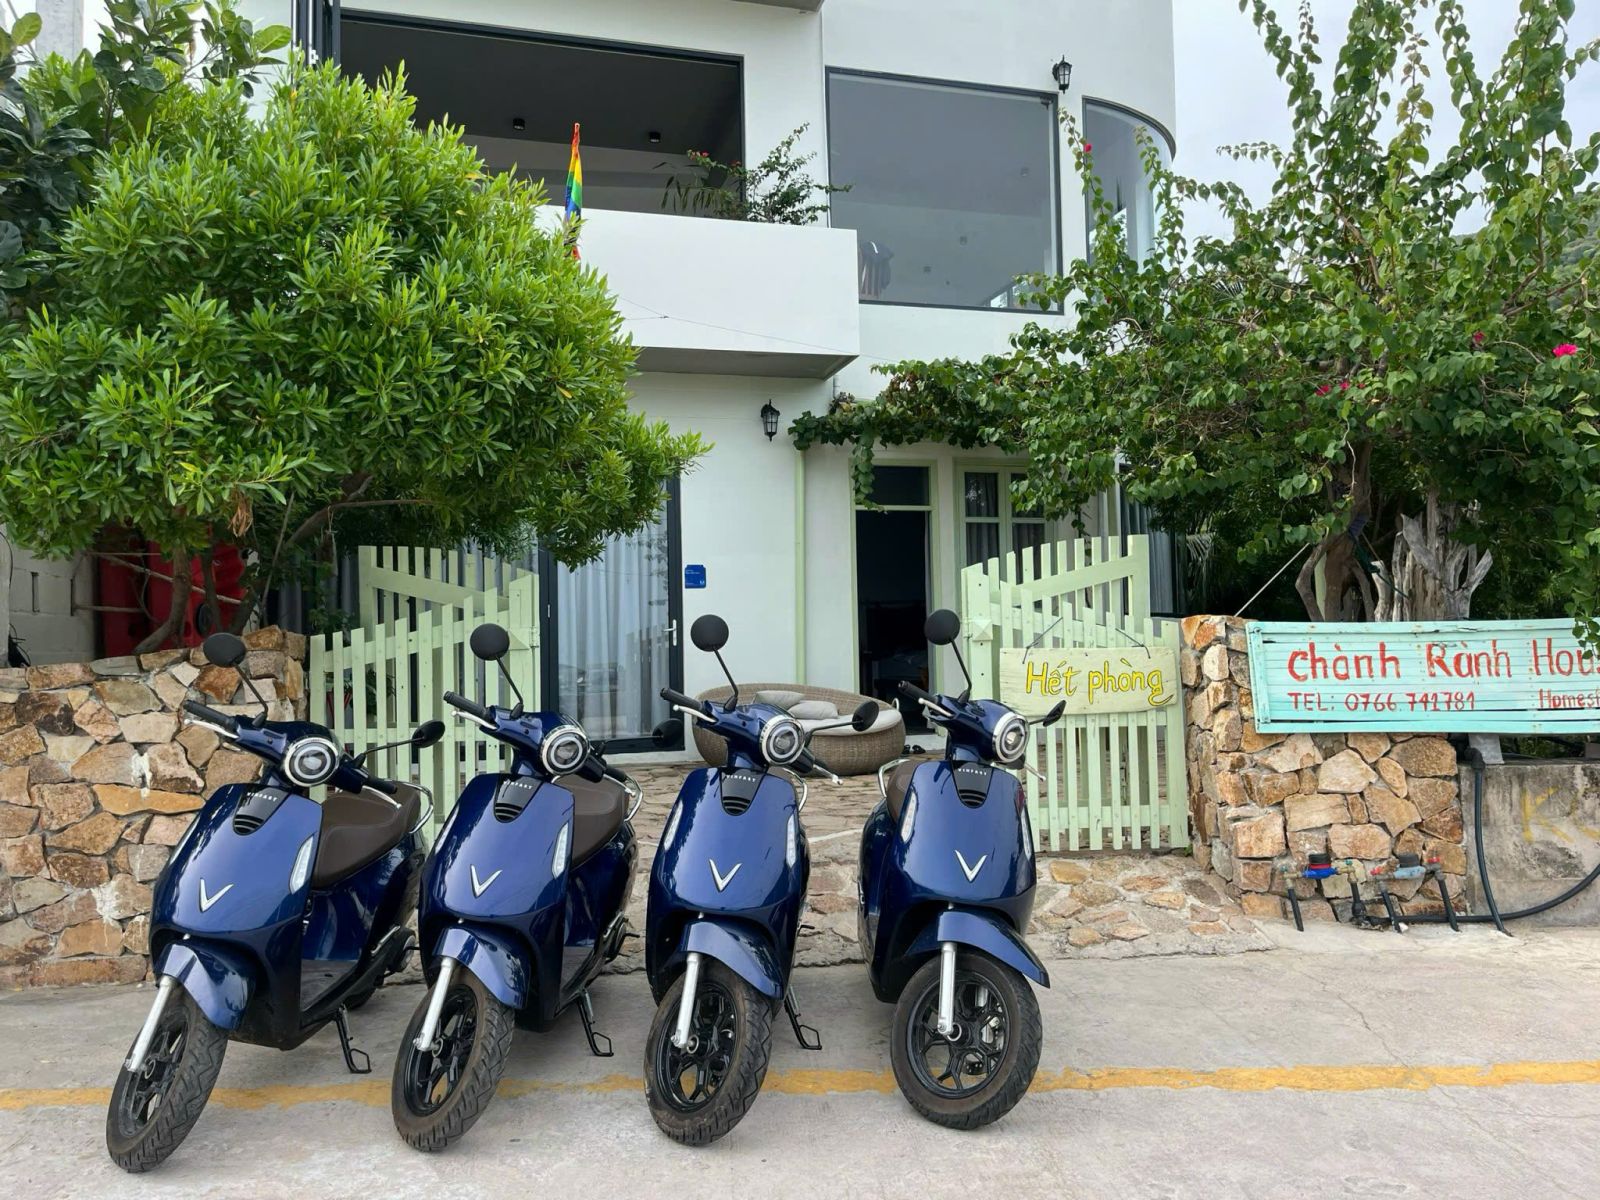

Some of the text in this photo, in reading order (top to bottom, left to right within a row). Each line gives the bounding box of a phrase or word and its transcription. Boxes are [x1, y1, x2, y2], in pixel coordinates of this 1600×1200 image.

[1026, 657, 1174, 706] Hết phòng
[1288, 637, 1600, 682] Chành Rành Hou
[1287, 691, 1475, 712] TEL: 0766 741781
